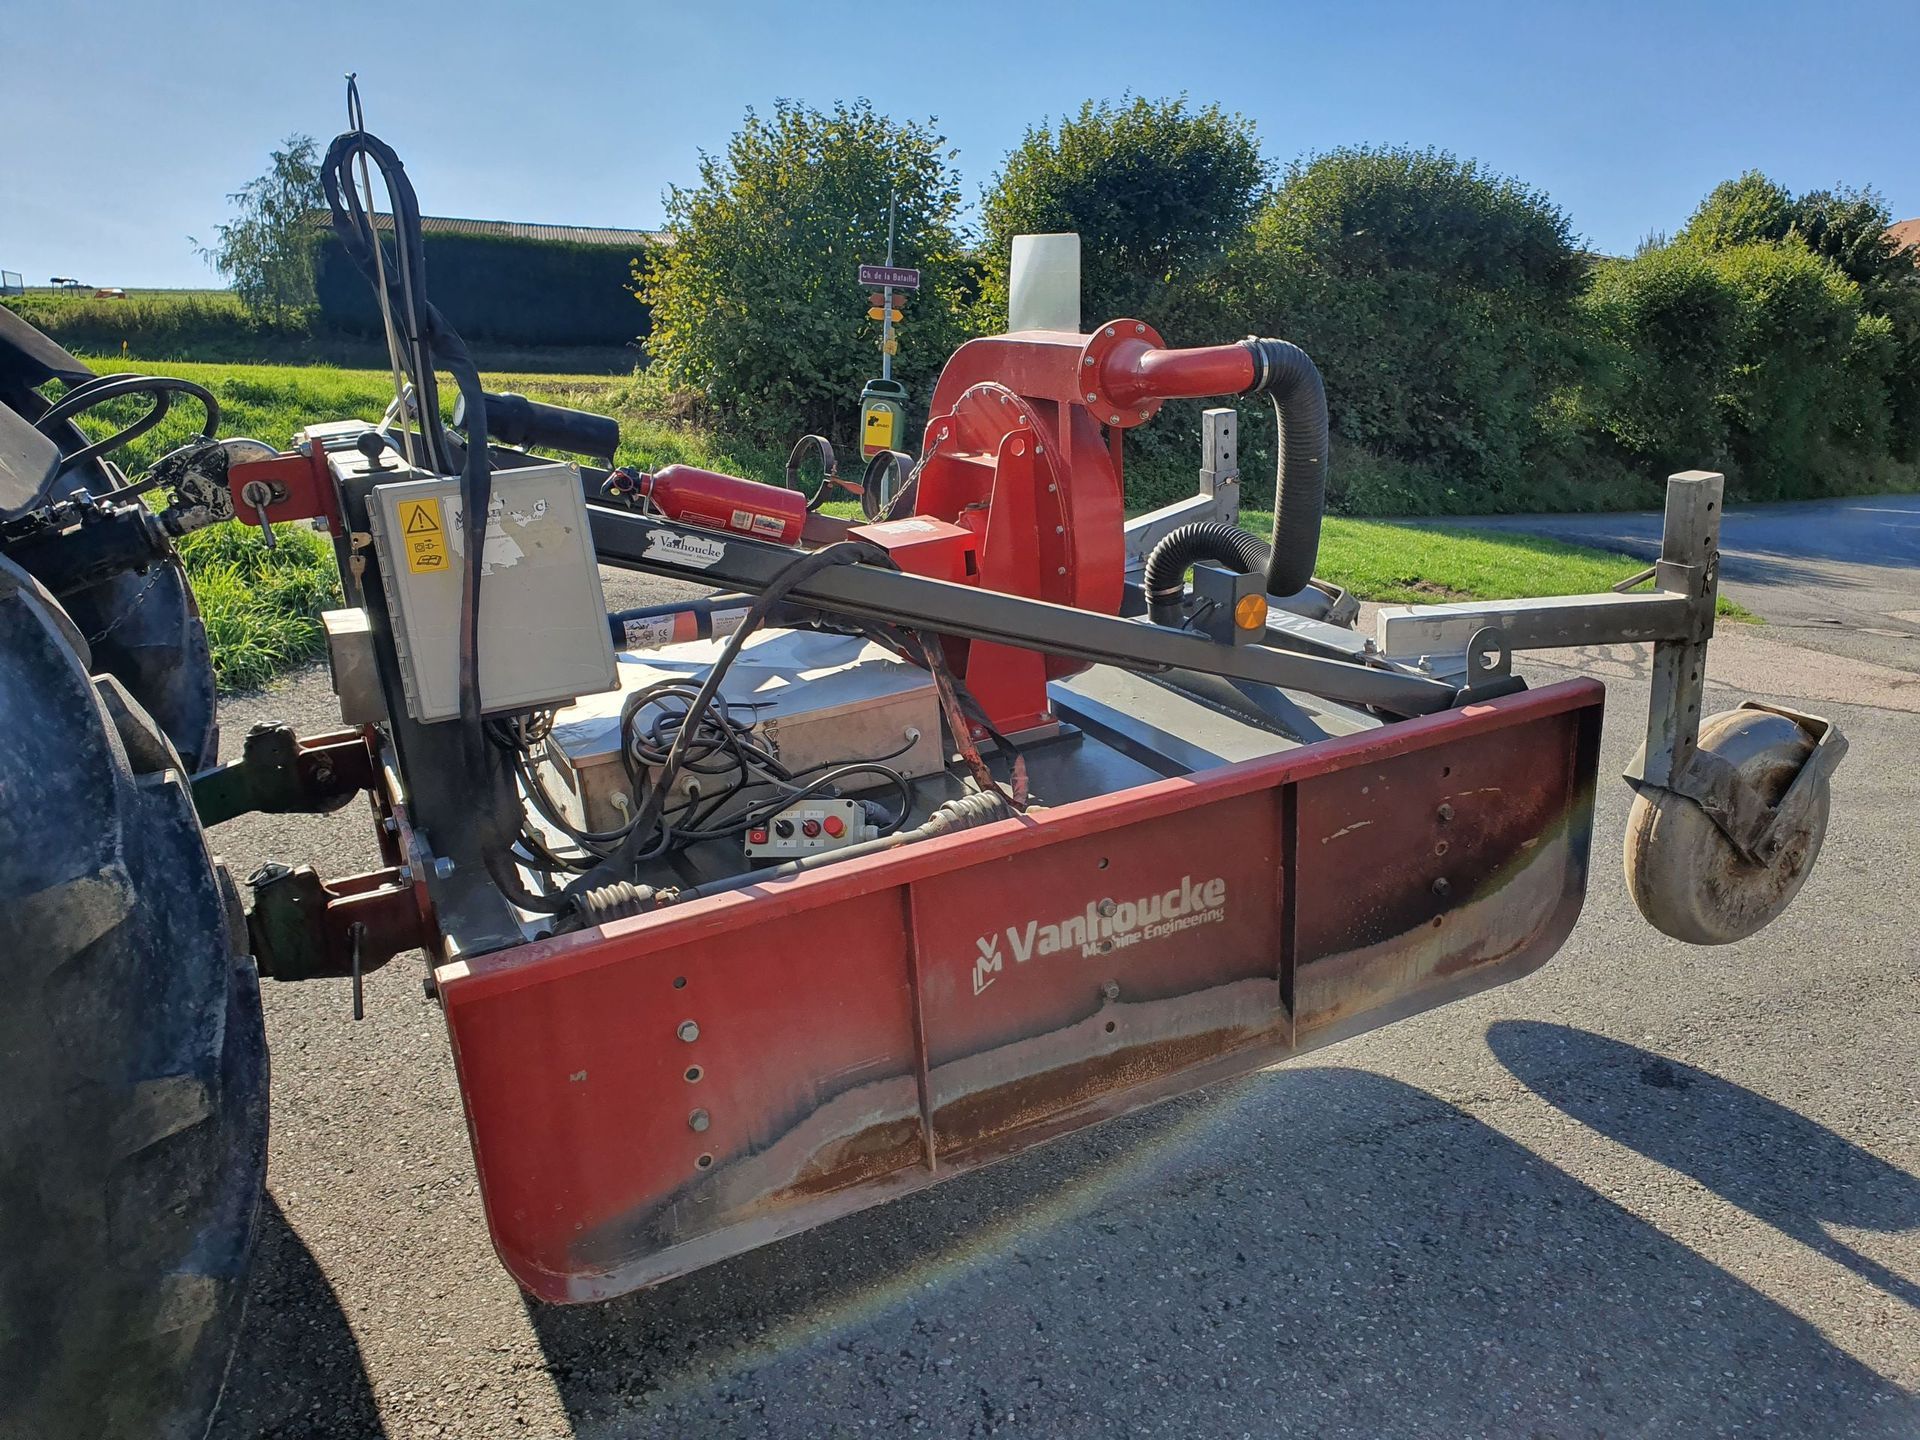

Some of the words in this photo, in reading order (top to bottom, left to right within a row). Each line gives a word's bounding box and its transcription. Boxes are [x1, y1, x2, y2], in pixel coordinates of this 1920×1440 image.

[874, 271, 882, 280] de
[884, 272, 890, 280] la
[892, 273, 916, 283] Bataille
[1006, 875, 1226, 963] Vanhoucke
[1144, 907, 1225, 939] Engineering
